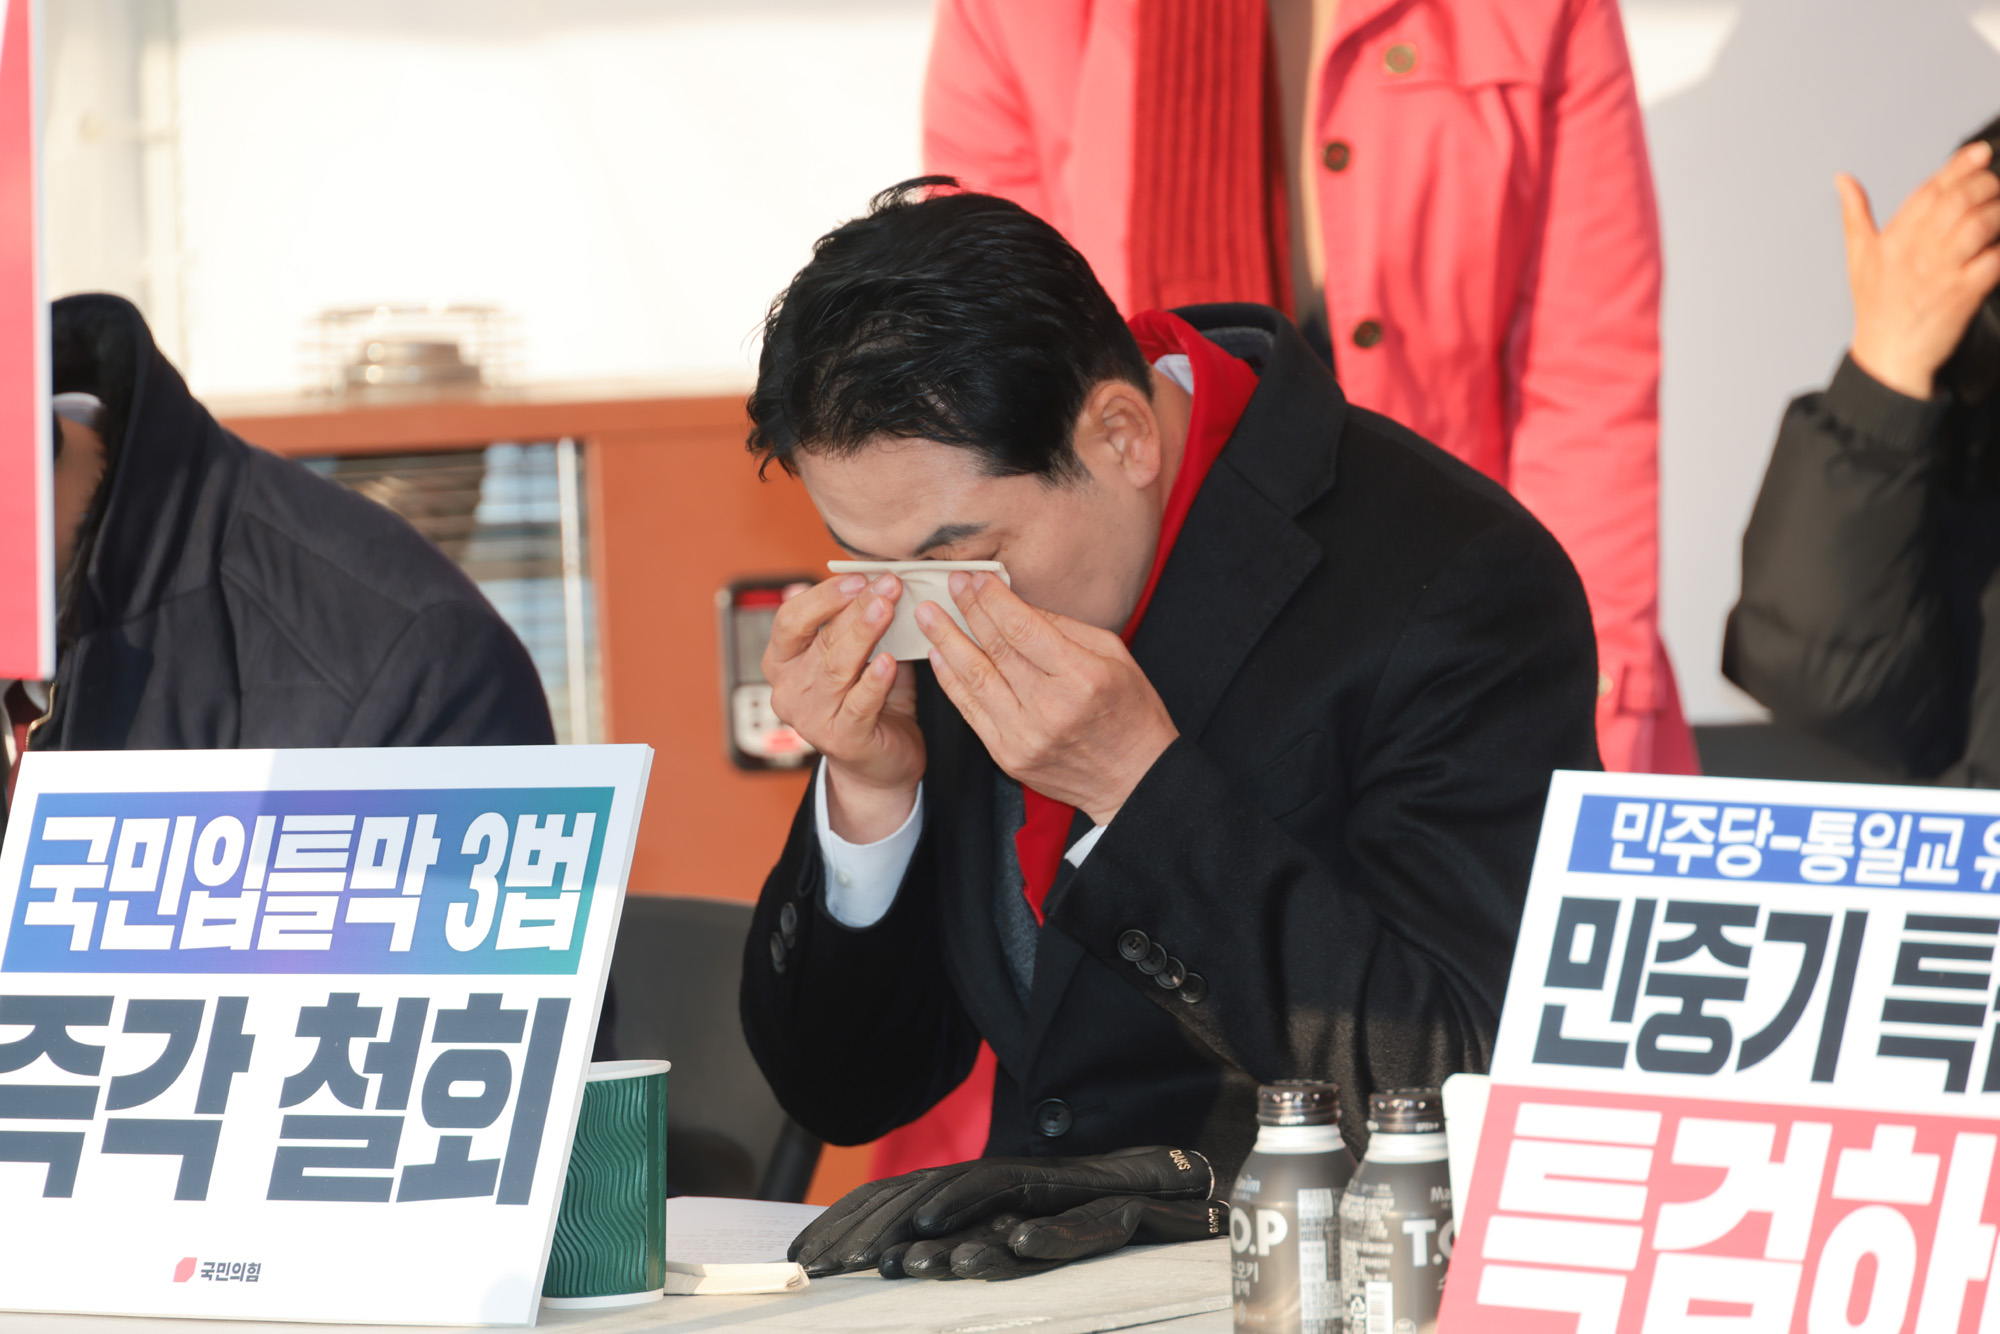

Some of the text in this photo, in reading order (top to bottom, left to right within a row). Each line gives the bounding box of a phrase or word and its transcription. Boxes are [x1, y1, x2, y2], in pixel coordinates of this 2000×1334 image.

[24, 811, 597, 952] 국민입틀막 3법
[1609, 801, 1965, 885] 민주당-통일교
[1532, 895, 2000, 1094] 민중기 특
[0, 992, 572, 1206] 즉각 철회
[200, 1261, 262, 1283] 국민의힘
[1476, 1101, 2000, 1334] 특검하
